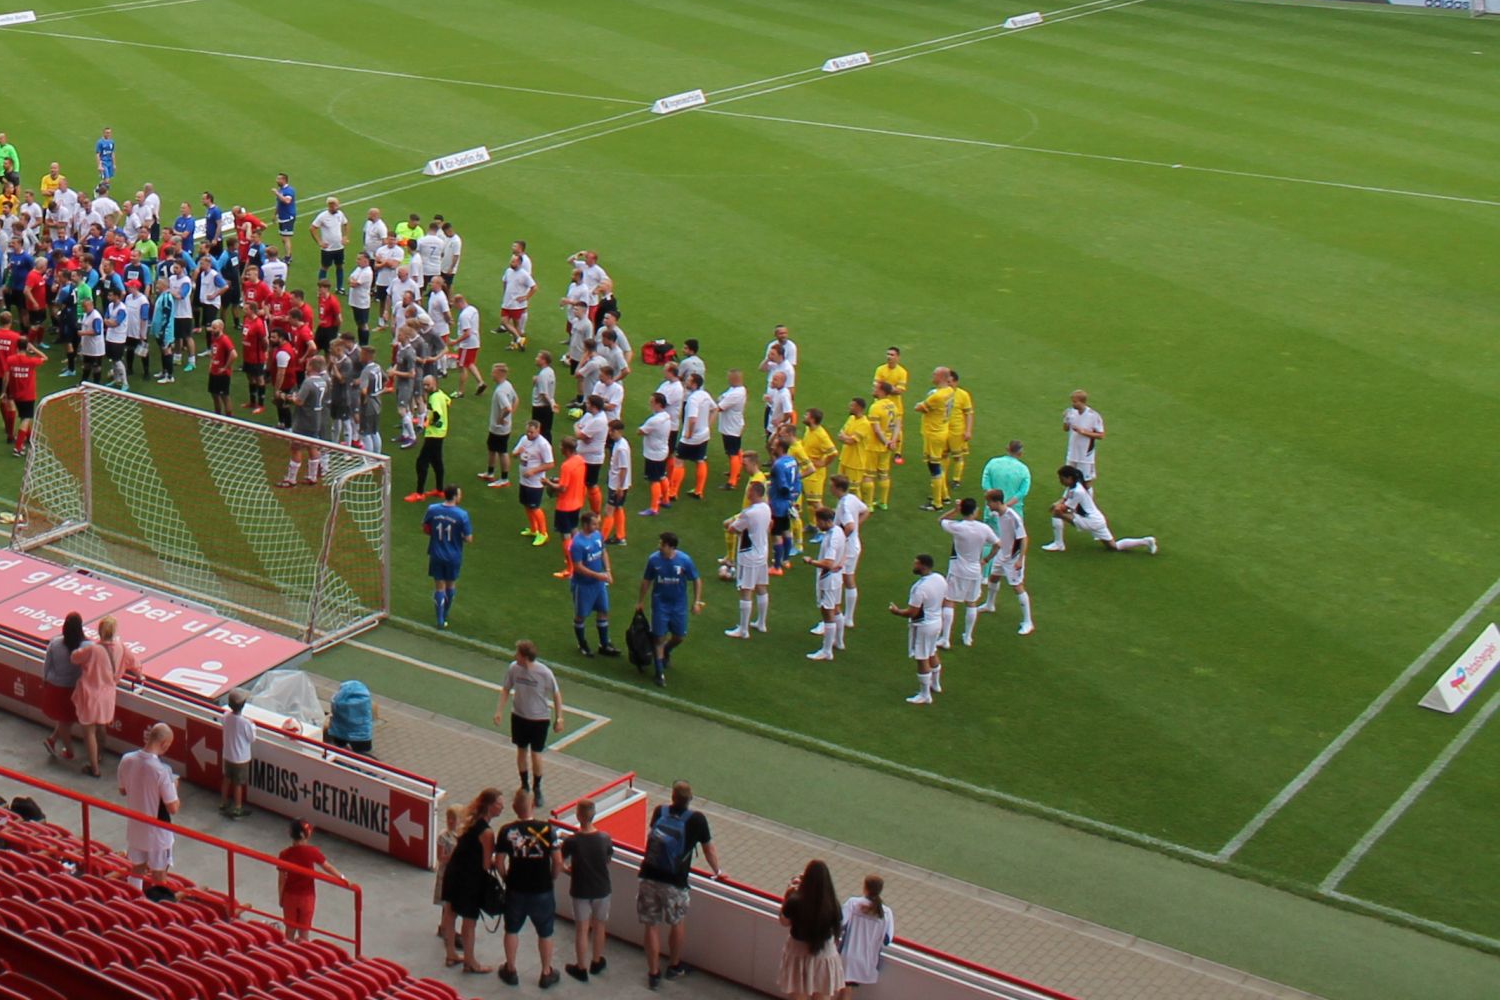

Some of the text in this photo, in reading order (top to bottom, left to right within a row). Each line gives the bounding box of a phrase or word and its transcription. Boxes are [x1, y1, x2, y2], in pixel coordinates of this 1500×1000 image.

[429, 246, 436, 255] 7
[373, 372, 383, 392] 11
[318, 385, 326, 402] 7
[436, 522, 453, 542] 11
[22, 571, 113, 603] gibt's
[126, 599, 182, 625] bei
[182, 619, 261, 650] uns!
[248, 758, 390, 836] IMBISS+GETRÄNKE
